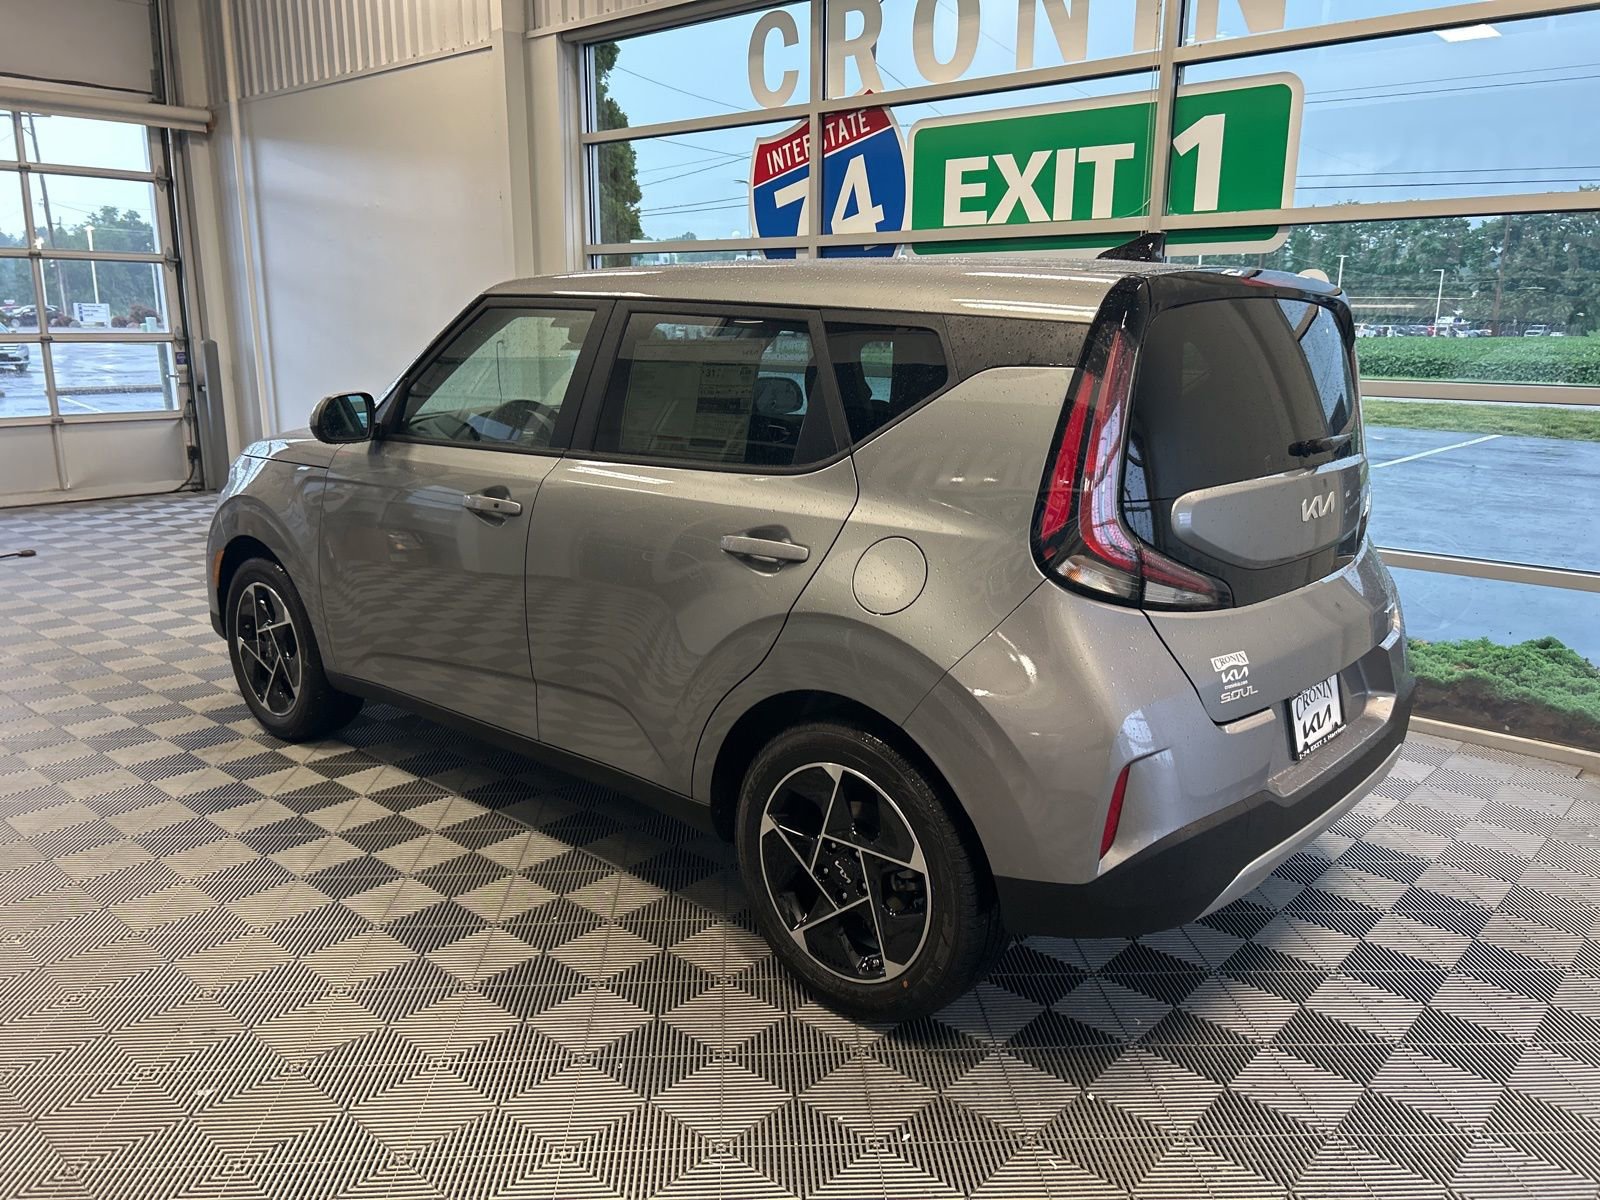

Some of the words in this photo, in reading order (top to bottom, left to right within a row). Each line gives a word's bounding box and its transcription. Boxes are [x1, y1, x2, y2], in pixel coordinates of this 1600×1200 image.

[766, 109, 870, 175] INTERTATE
[943, 142, 1135, 227] EXIT
[1172, 114, 1225, 212] 1
[773, 153, 885, 250] 74
[1213, 652, 1247, 670] CRONIN
[1220, 685, 1259, 704] SOUL
[1296, 678, 1332, 720] CRONIN
